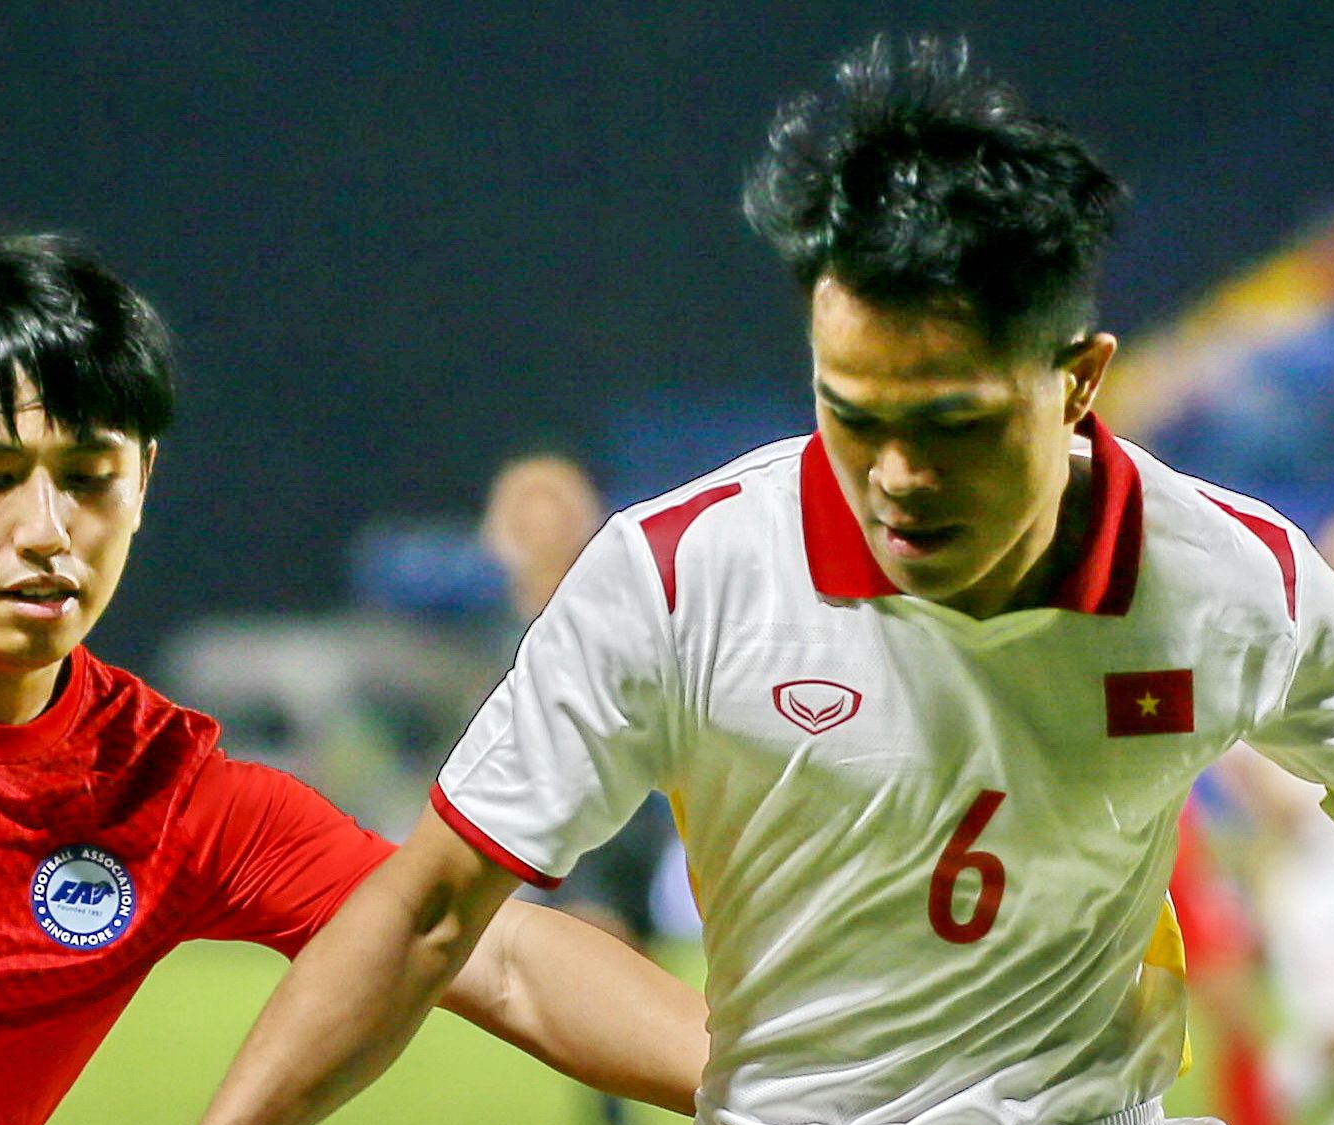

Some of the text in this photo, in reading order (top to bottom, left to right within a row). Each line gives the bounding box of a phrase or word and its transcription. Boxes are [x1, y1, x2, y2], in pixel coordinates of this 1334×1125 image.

[34, 849, 132, 917] FOOTBALL ASSOCIATION
[928, 789, 1006, 944] 6
[41, 918, 115, 946] SINGAPORE
